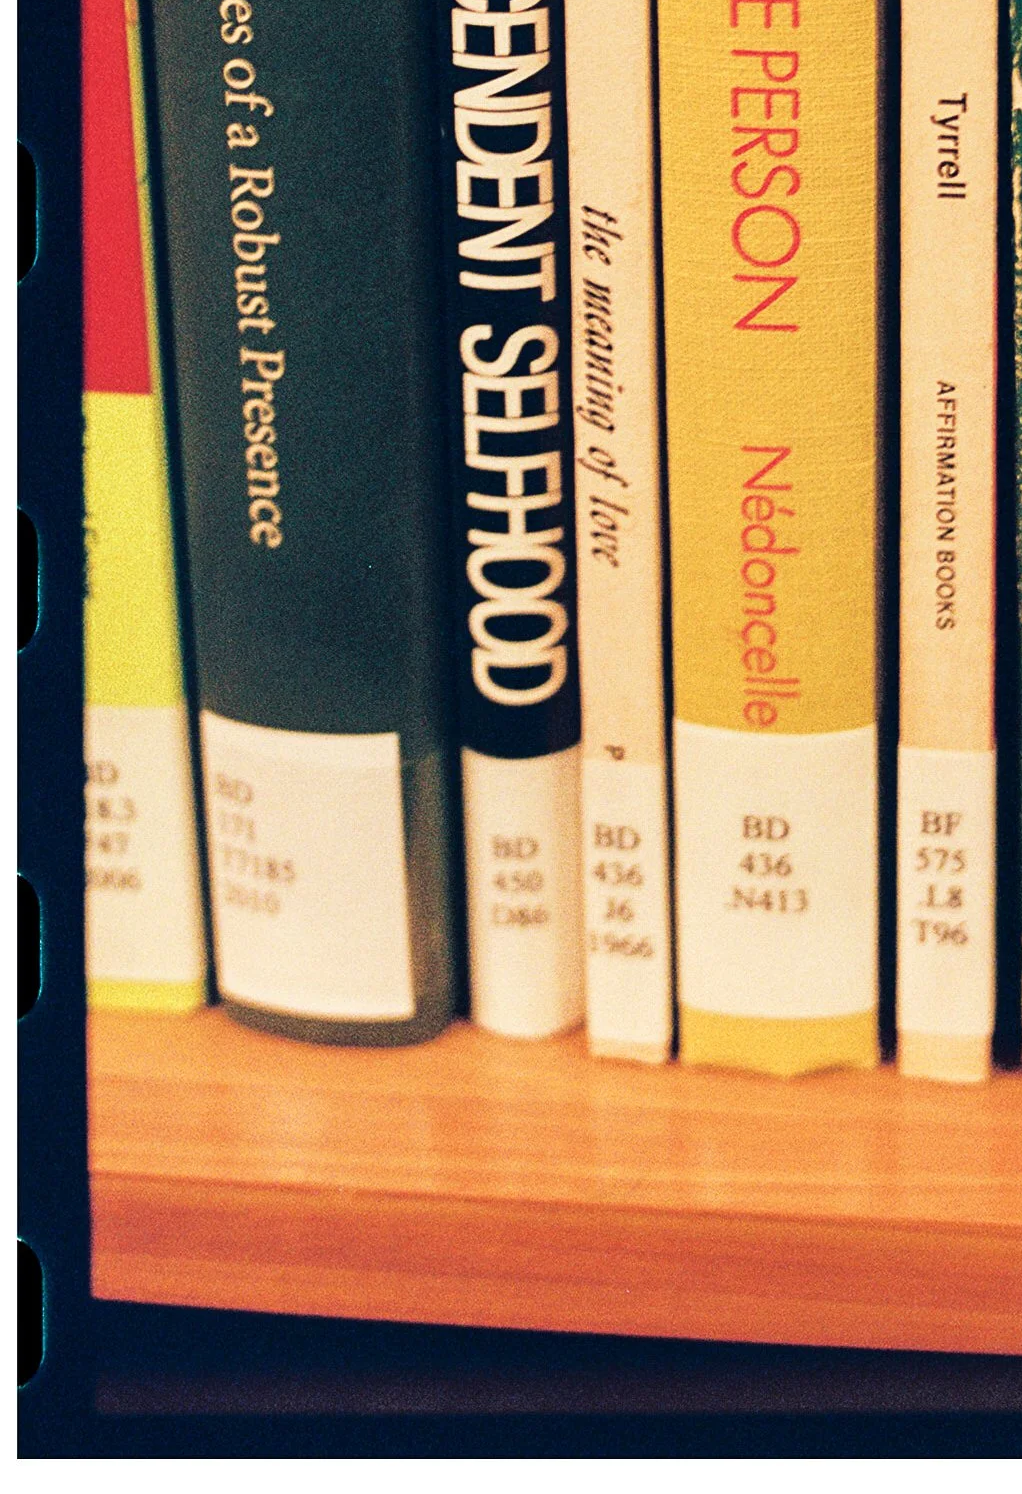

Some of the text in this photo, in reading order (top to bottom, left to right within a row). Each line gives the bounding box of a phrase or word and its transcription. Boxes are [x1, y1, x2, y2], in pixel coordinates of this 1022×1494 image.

[221, 58, 274, 116] of
[229, 119, 258, 149] a
[934, 94, 968, 202] Tyrrell
[730, 48, 801, 332] PERSON
[227, 164, 281, 336] Robust
[578, 204, 630, 568] the meaning of love
[238, 346, 286, 549] Presence
[460, 322, 569, 707] SELFHOOD
[937, 380, 956, 630] AFFIRMATION BOOKS
[740, 442, 801, 730] Nédoncelle
[214, 770, 255, 805] BD
[594, 821, 642, 852] BD
[742, 814, 791, 841] BD
[920, 809, 962, 836] BF
[492, 834, 540, 860] BD
[739, 852, 792, 877] 436
[915, 845, 967, 874] 575
[594, 859, 645, 888] 436
[911, 917, 970, 946] T96
